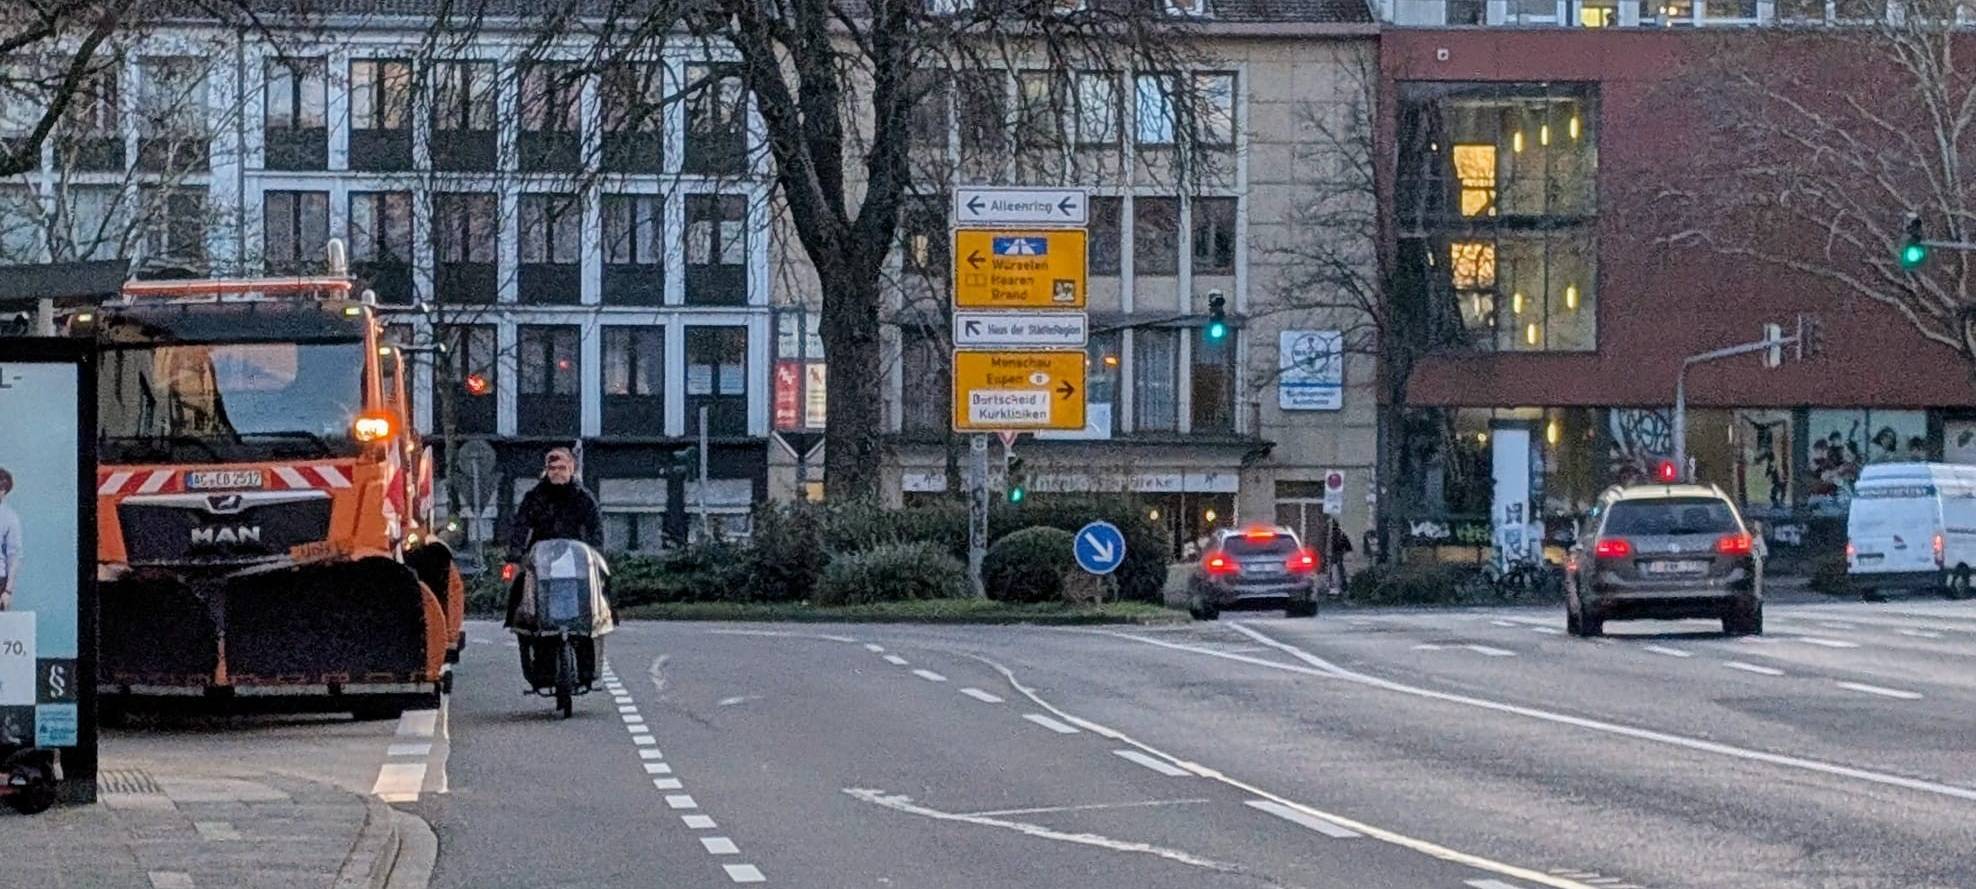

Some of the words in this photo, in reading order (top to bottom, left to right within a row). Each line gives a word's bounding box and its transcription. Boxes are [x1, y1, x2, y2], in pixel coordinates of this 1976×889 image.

[990, 200, 1053, 214] Alleenring
[992, 258, 1048, 271] Würselen
[991, 275, 1034, 285] Haaren
[991, 289, 1027, 299] Brand
[1011, 324, 1023, 335] der
[991, 357, 1052, 368] Monschau
[986, 374, 1024, 387] Eupen
[979, 407, 1047, 420] Kurkliniken
[191, 525, 260, 544] MAN
[3, 640, 27, 656] 70,
